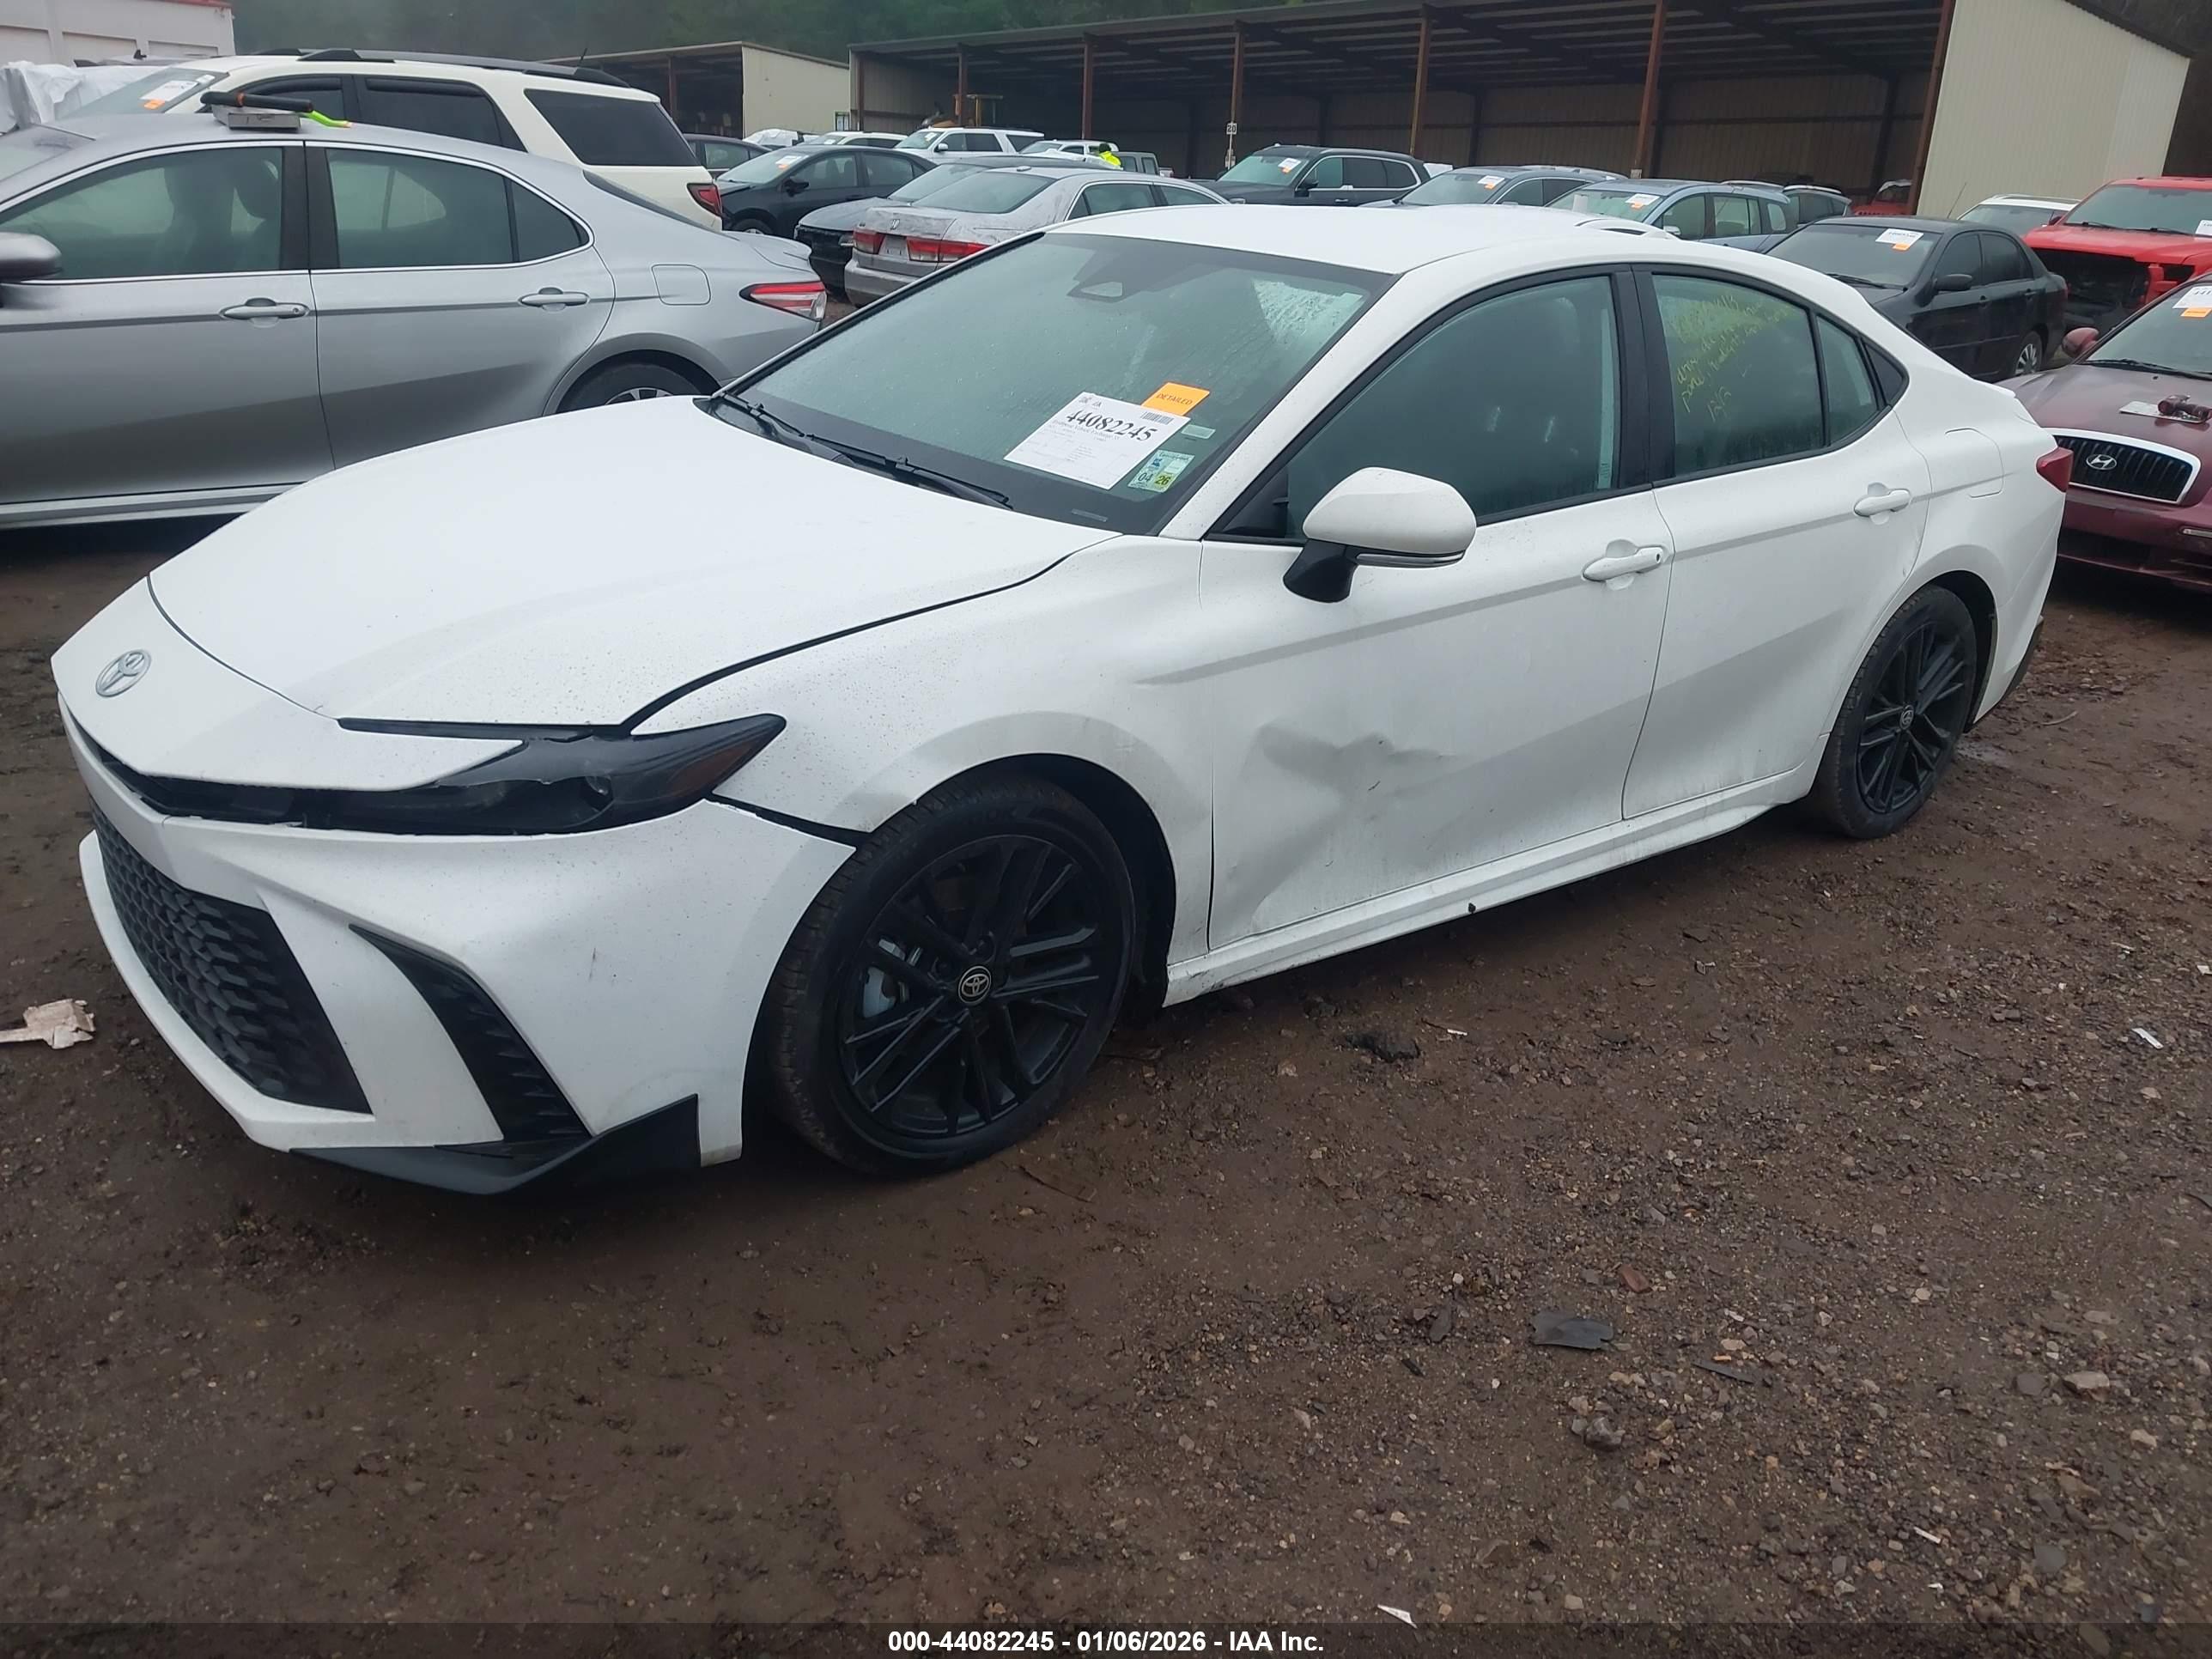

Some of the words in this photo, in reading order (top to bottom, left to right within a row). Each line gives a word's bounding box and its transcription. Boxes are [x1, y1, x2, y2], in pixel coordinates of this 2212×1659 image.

[1156, 393, 1193, 405] DETAILED
[1066, 410, 1158, 441] 44082245
[1138, 472, 1154, 482] 04
[1154, 475, 1171, 486] 26
